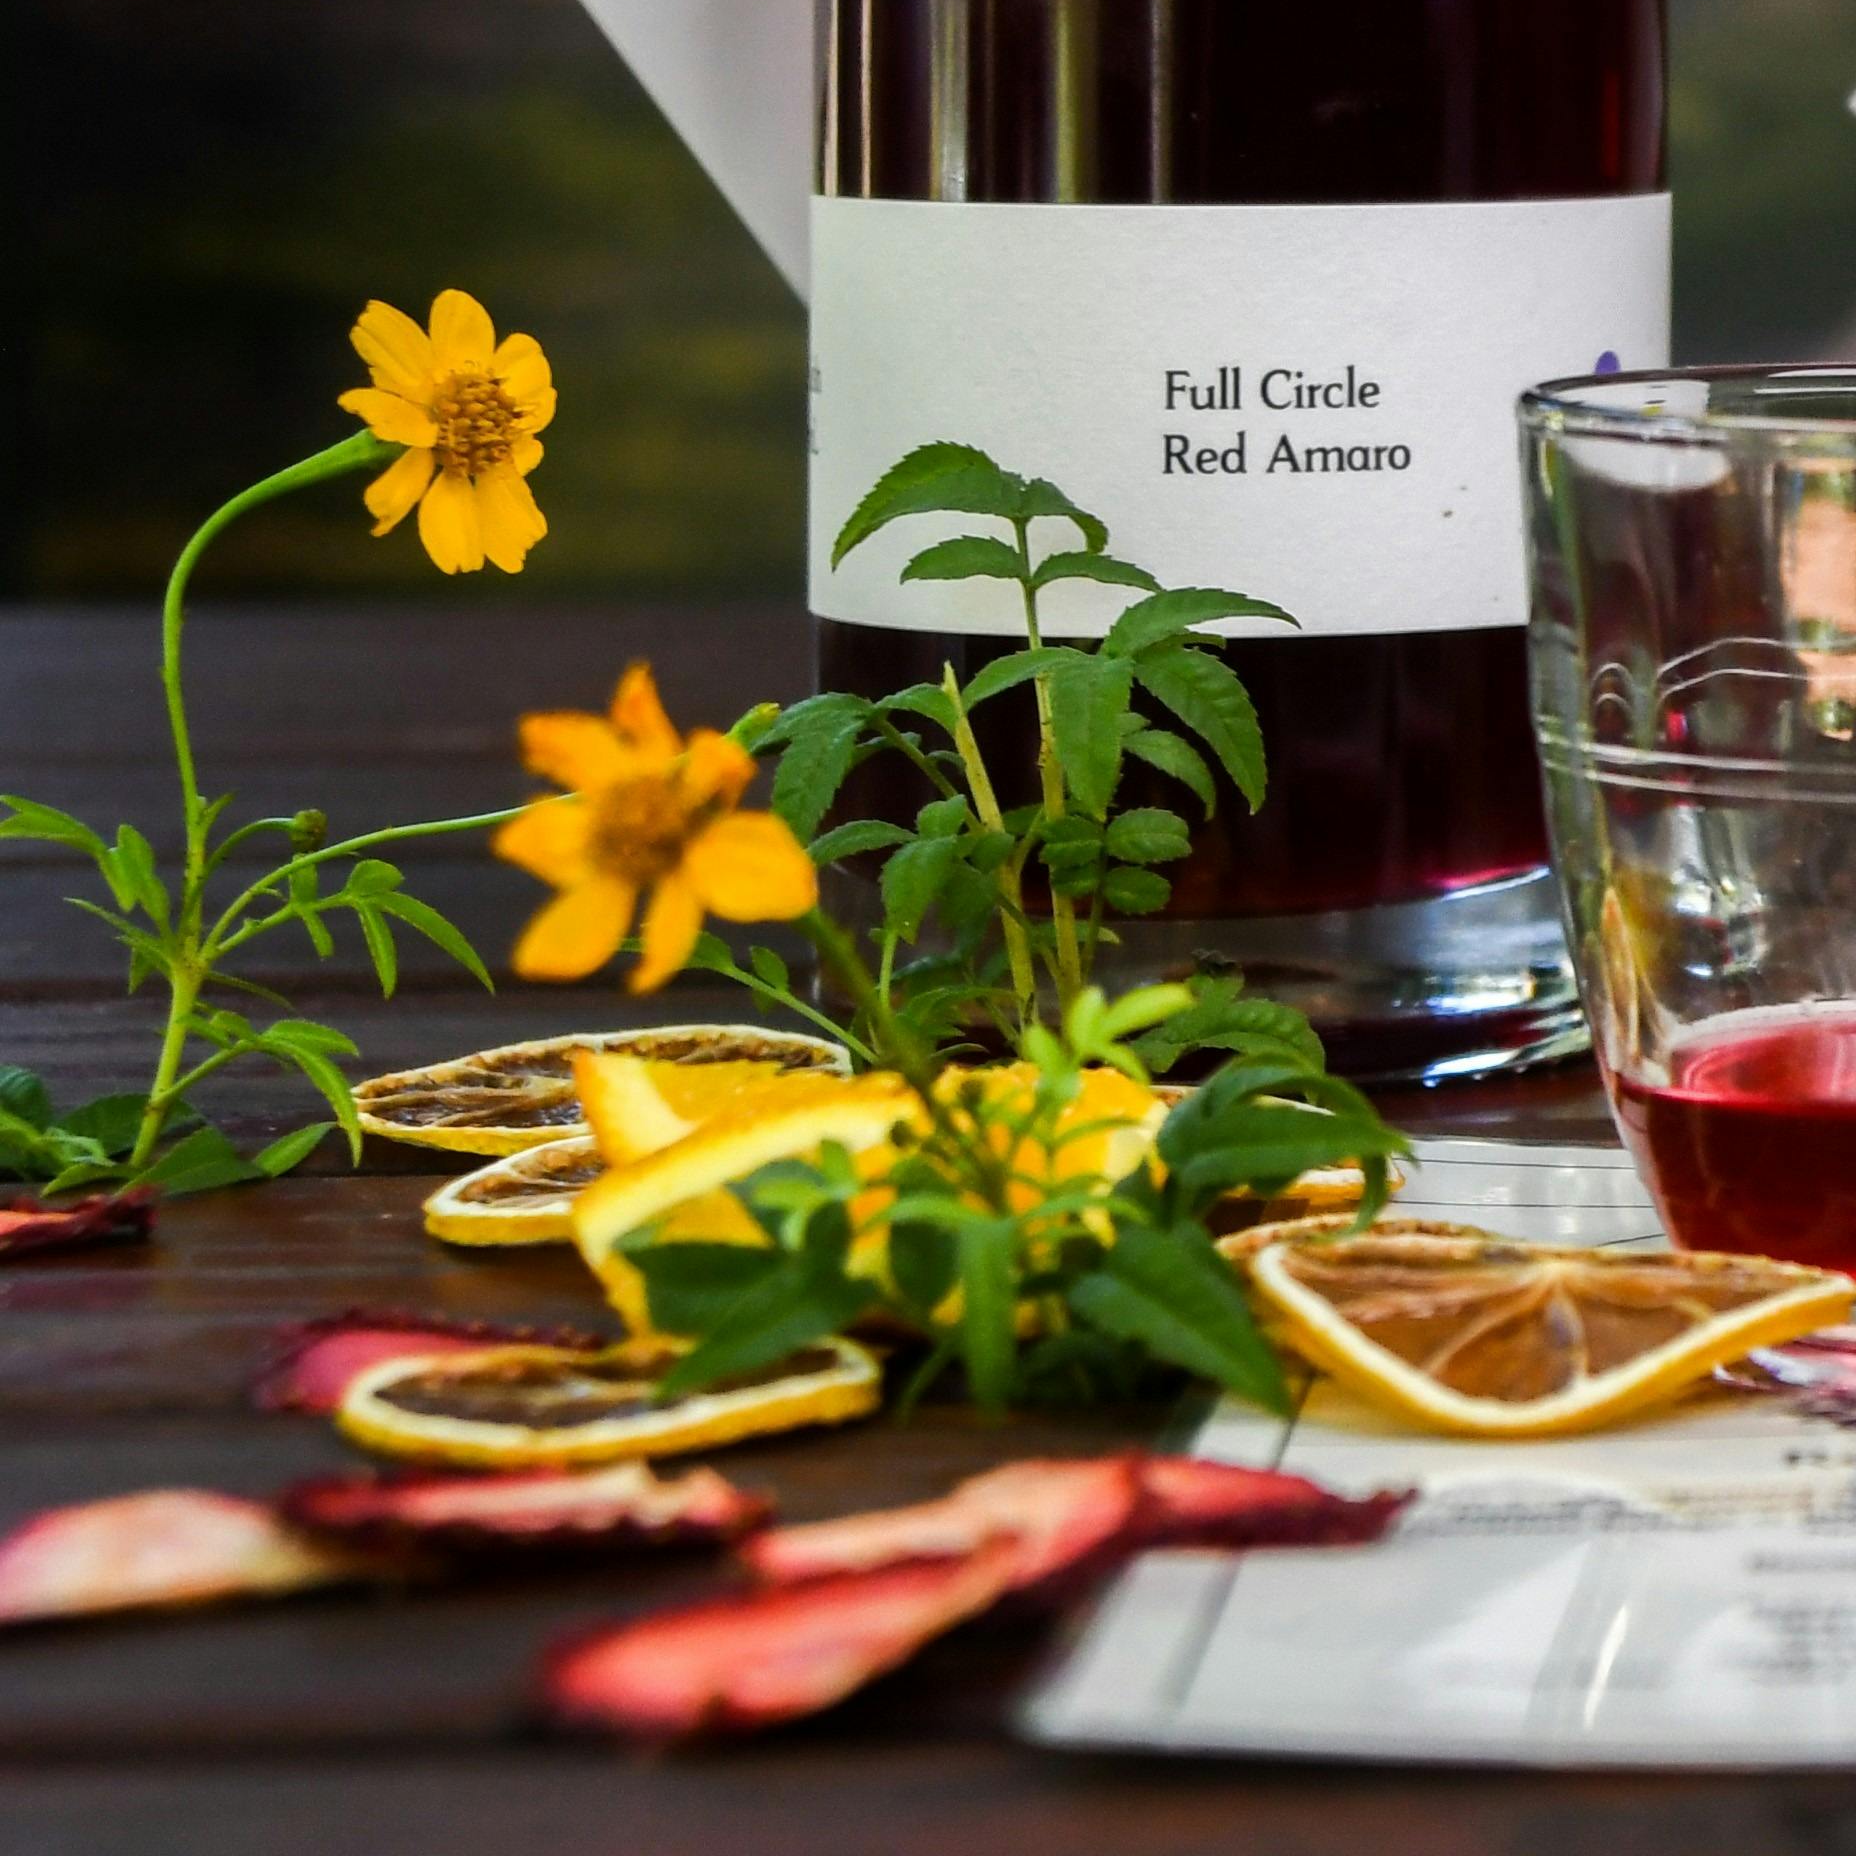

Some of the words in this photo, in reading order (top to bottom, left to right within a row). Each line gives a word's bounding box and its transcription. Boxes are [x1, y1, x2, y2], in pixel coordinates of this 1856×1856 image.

[1165, 366, 1240, 411] Full
[1260, 365, 1381, 411] Circle
[1163, 432, 1247, 475] Red
[1267, 435, 1412, 475] Amaro
